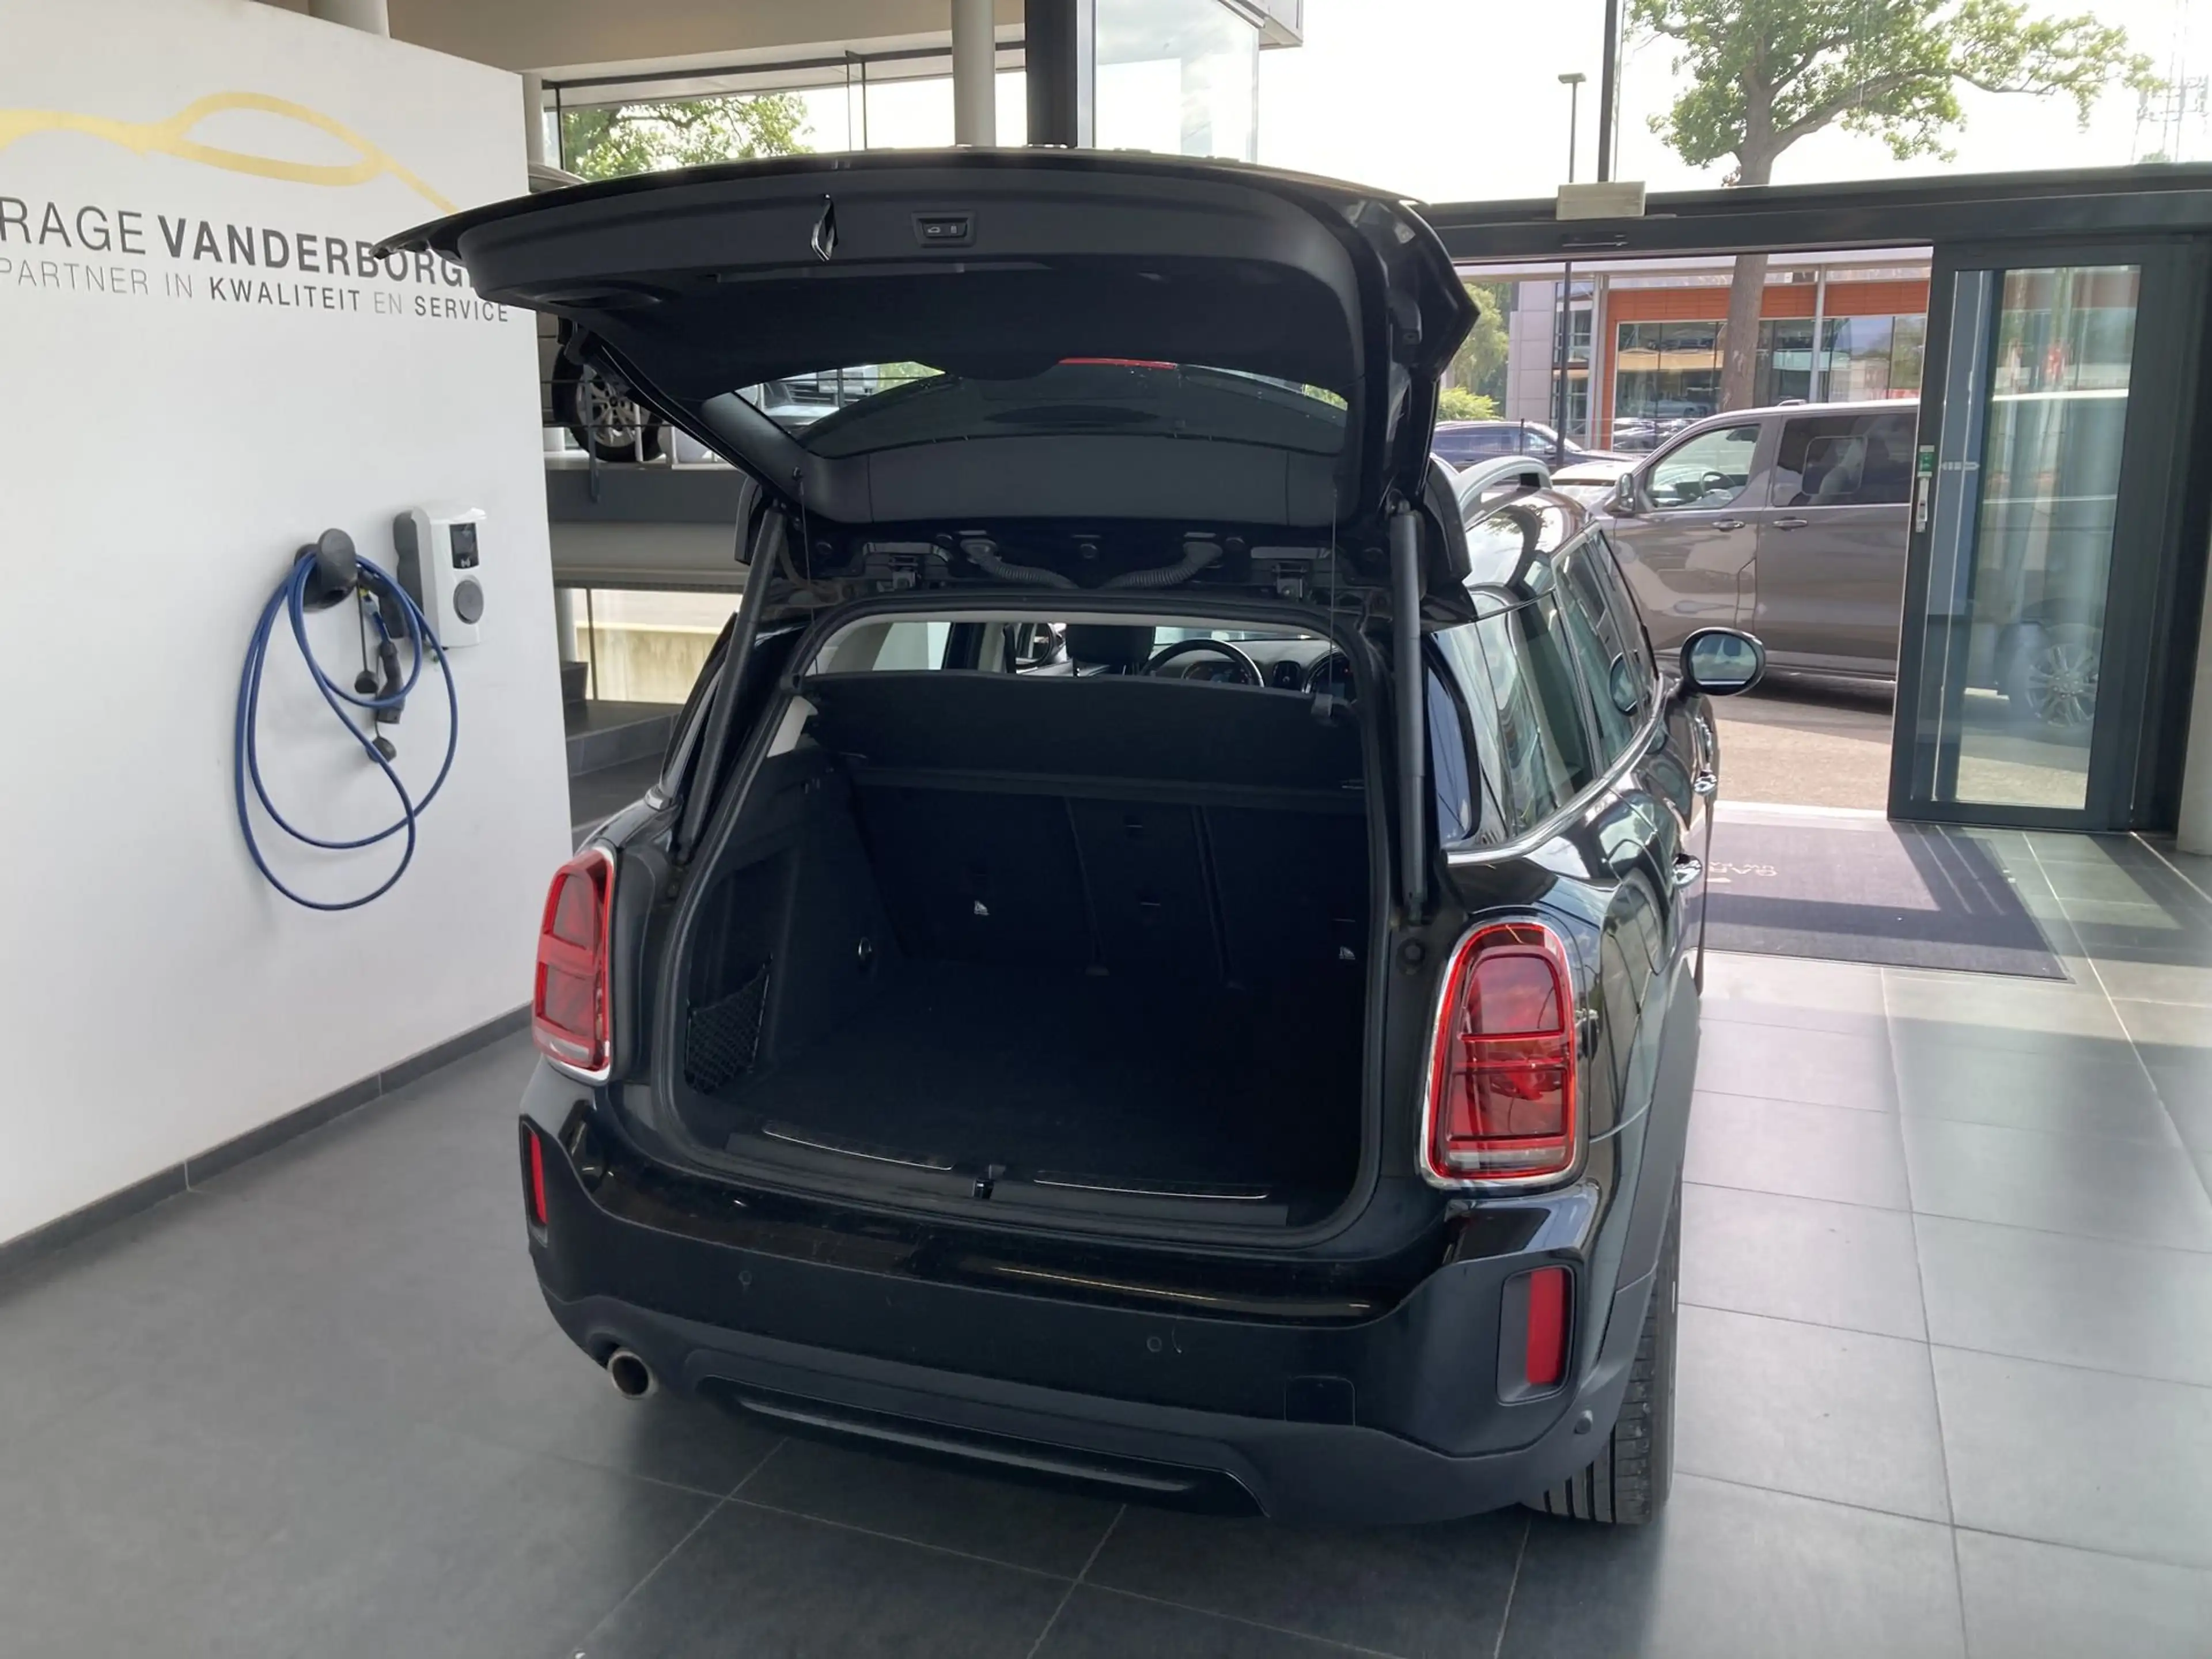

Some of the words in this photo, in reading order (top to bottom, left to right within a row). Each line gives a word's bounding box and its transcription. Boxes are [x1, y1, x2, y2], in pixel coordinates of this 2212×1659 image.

[0, 196, 146, 255] RAGE
[157, 215, 475, 289] VANDERBORG
[165, 271, 193, 299] IN
[210, 276, 361, 312] KWALITEIT
[374, 291, 403, 315] EN
[414, 295, 509, 323] SERVICE
